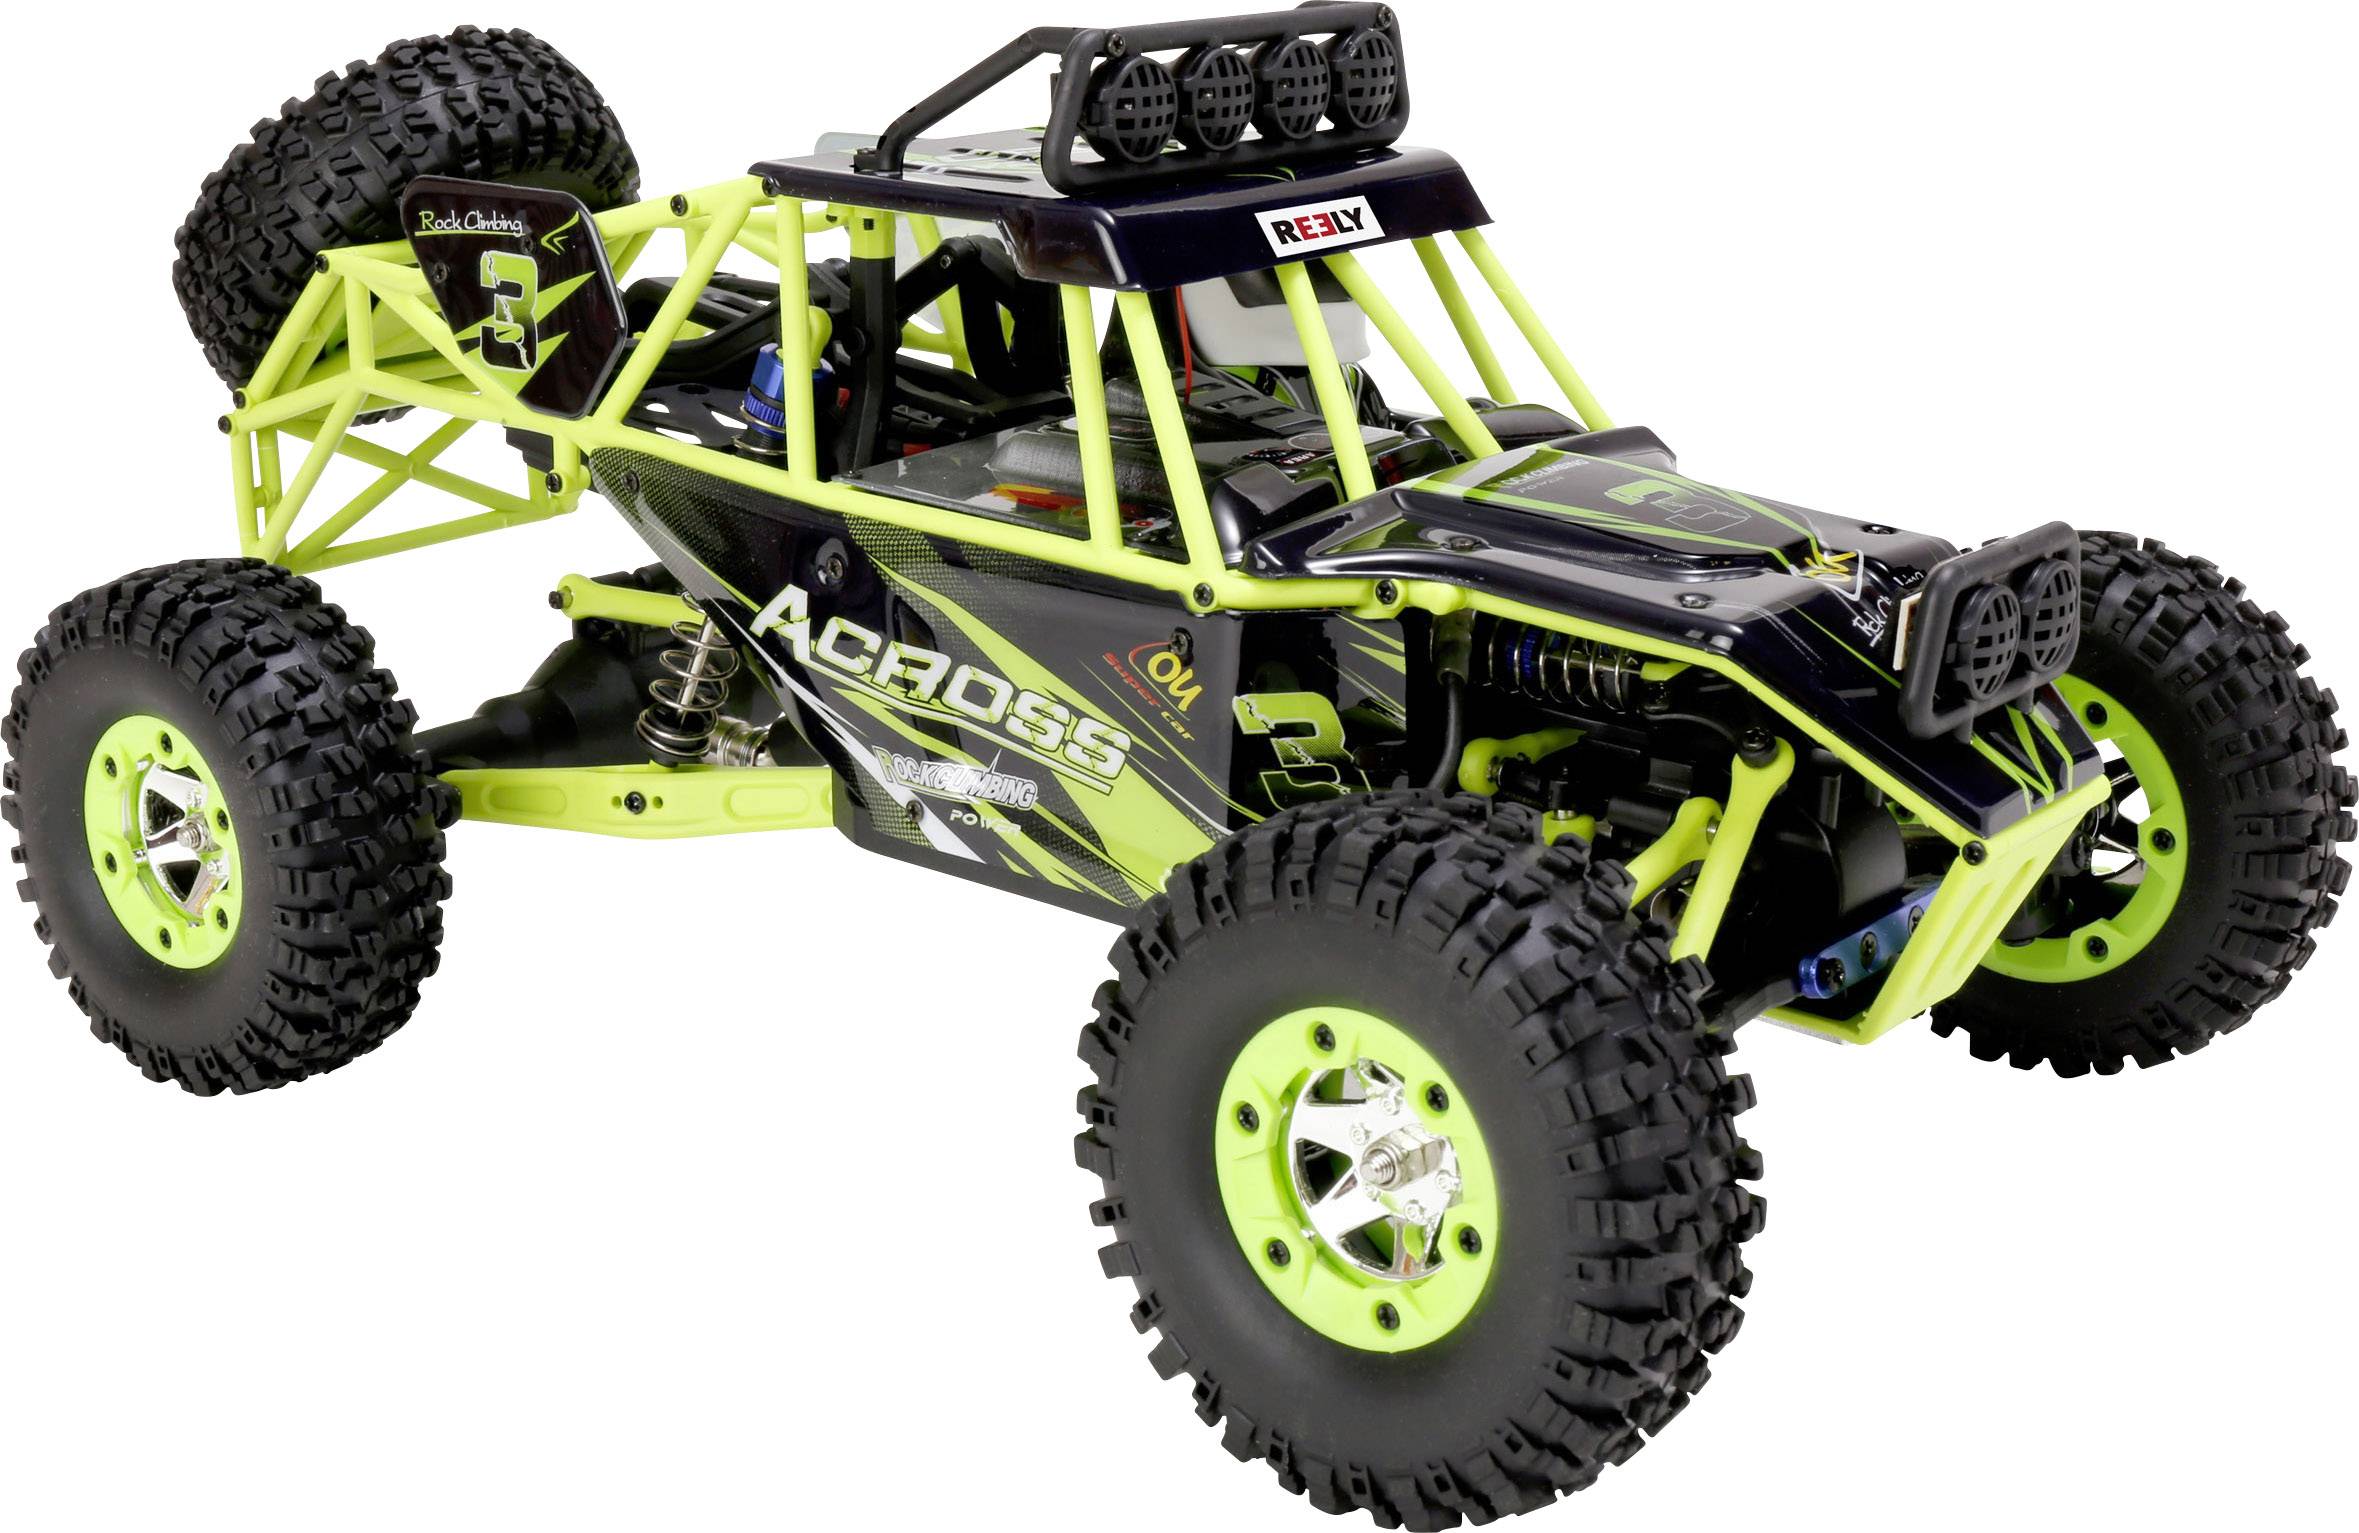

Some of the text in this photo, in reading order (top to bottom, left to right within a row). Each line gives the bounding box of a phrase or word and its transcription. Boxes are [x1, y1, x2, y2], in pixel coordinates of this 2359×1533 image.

[419, 209, 524, 237] Rock Climbing
[1271, 207, 1364, 244] REELY
[480, 250, 539, 373] 3
[749, 583, 1133, 780] ACROSS
[1232, 691, 1373, 812] 3
